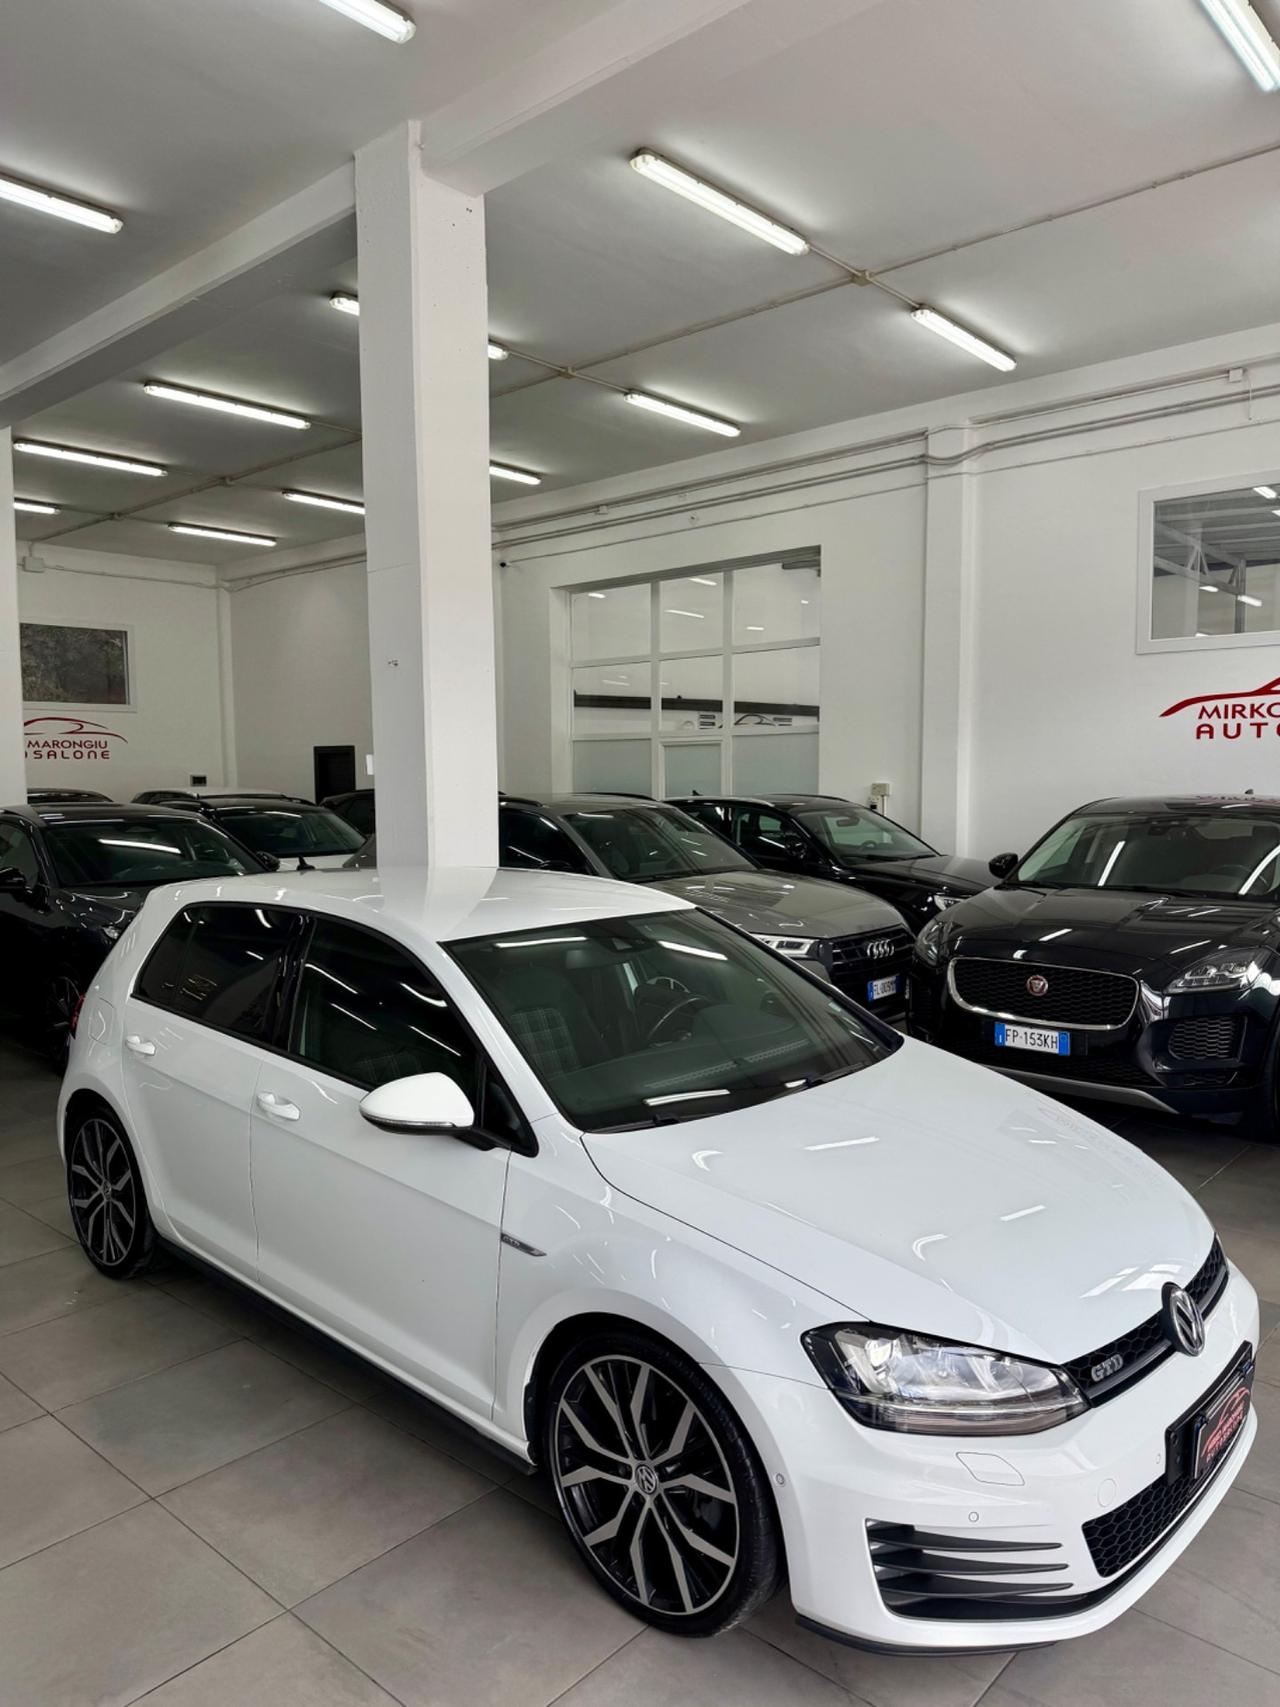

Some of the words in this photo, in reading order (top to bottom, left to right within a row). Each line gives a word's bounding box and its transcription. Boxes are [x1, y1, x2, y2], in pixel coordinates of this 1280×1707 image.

[1198, 702, 1280, 720] MIRKO
[1196, 722, 1280, 740] AUT
[27, 739, 108, 749] MARONGIU
[25, 750, 110, 760] SALONE
[1091, 1353, 1124, 1382] GTD
